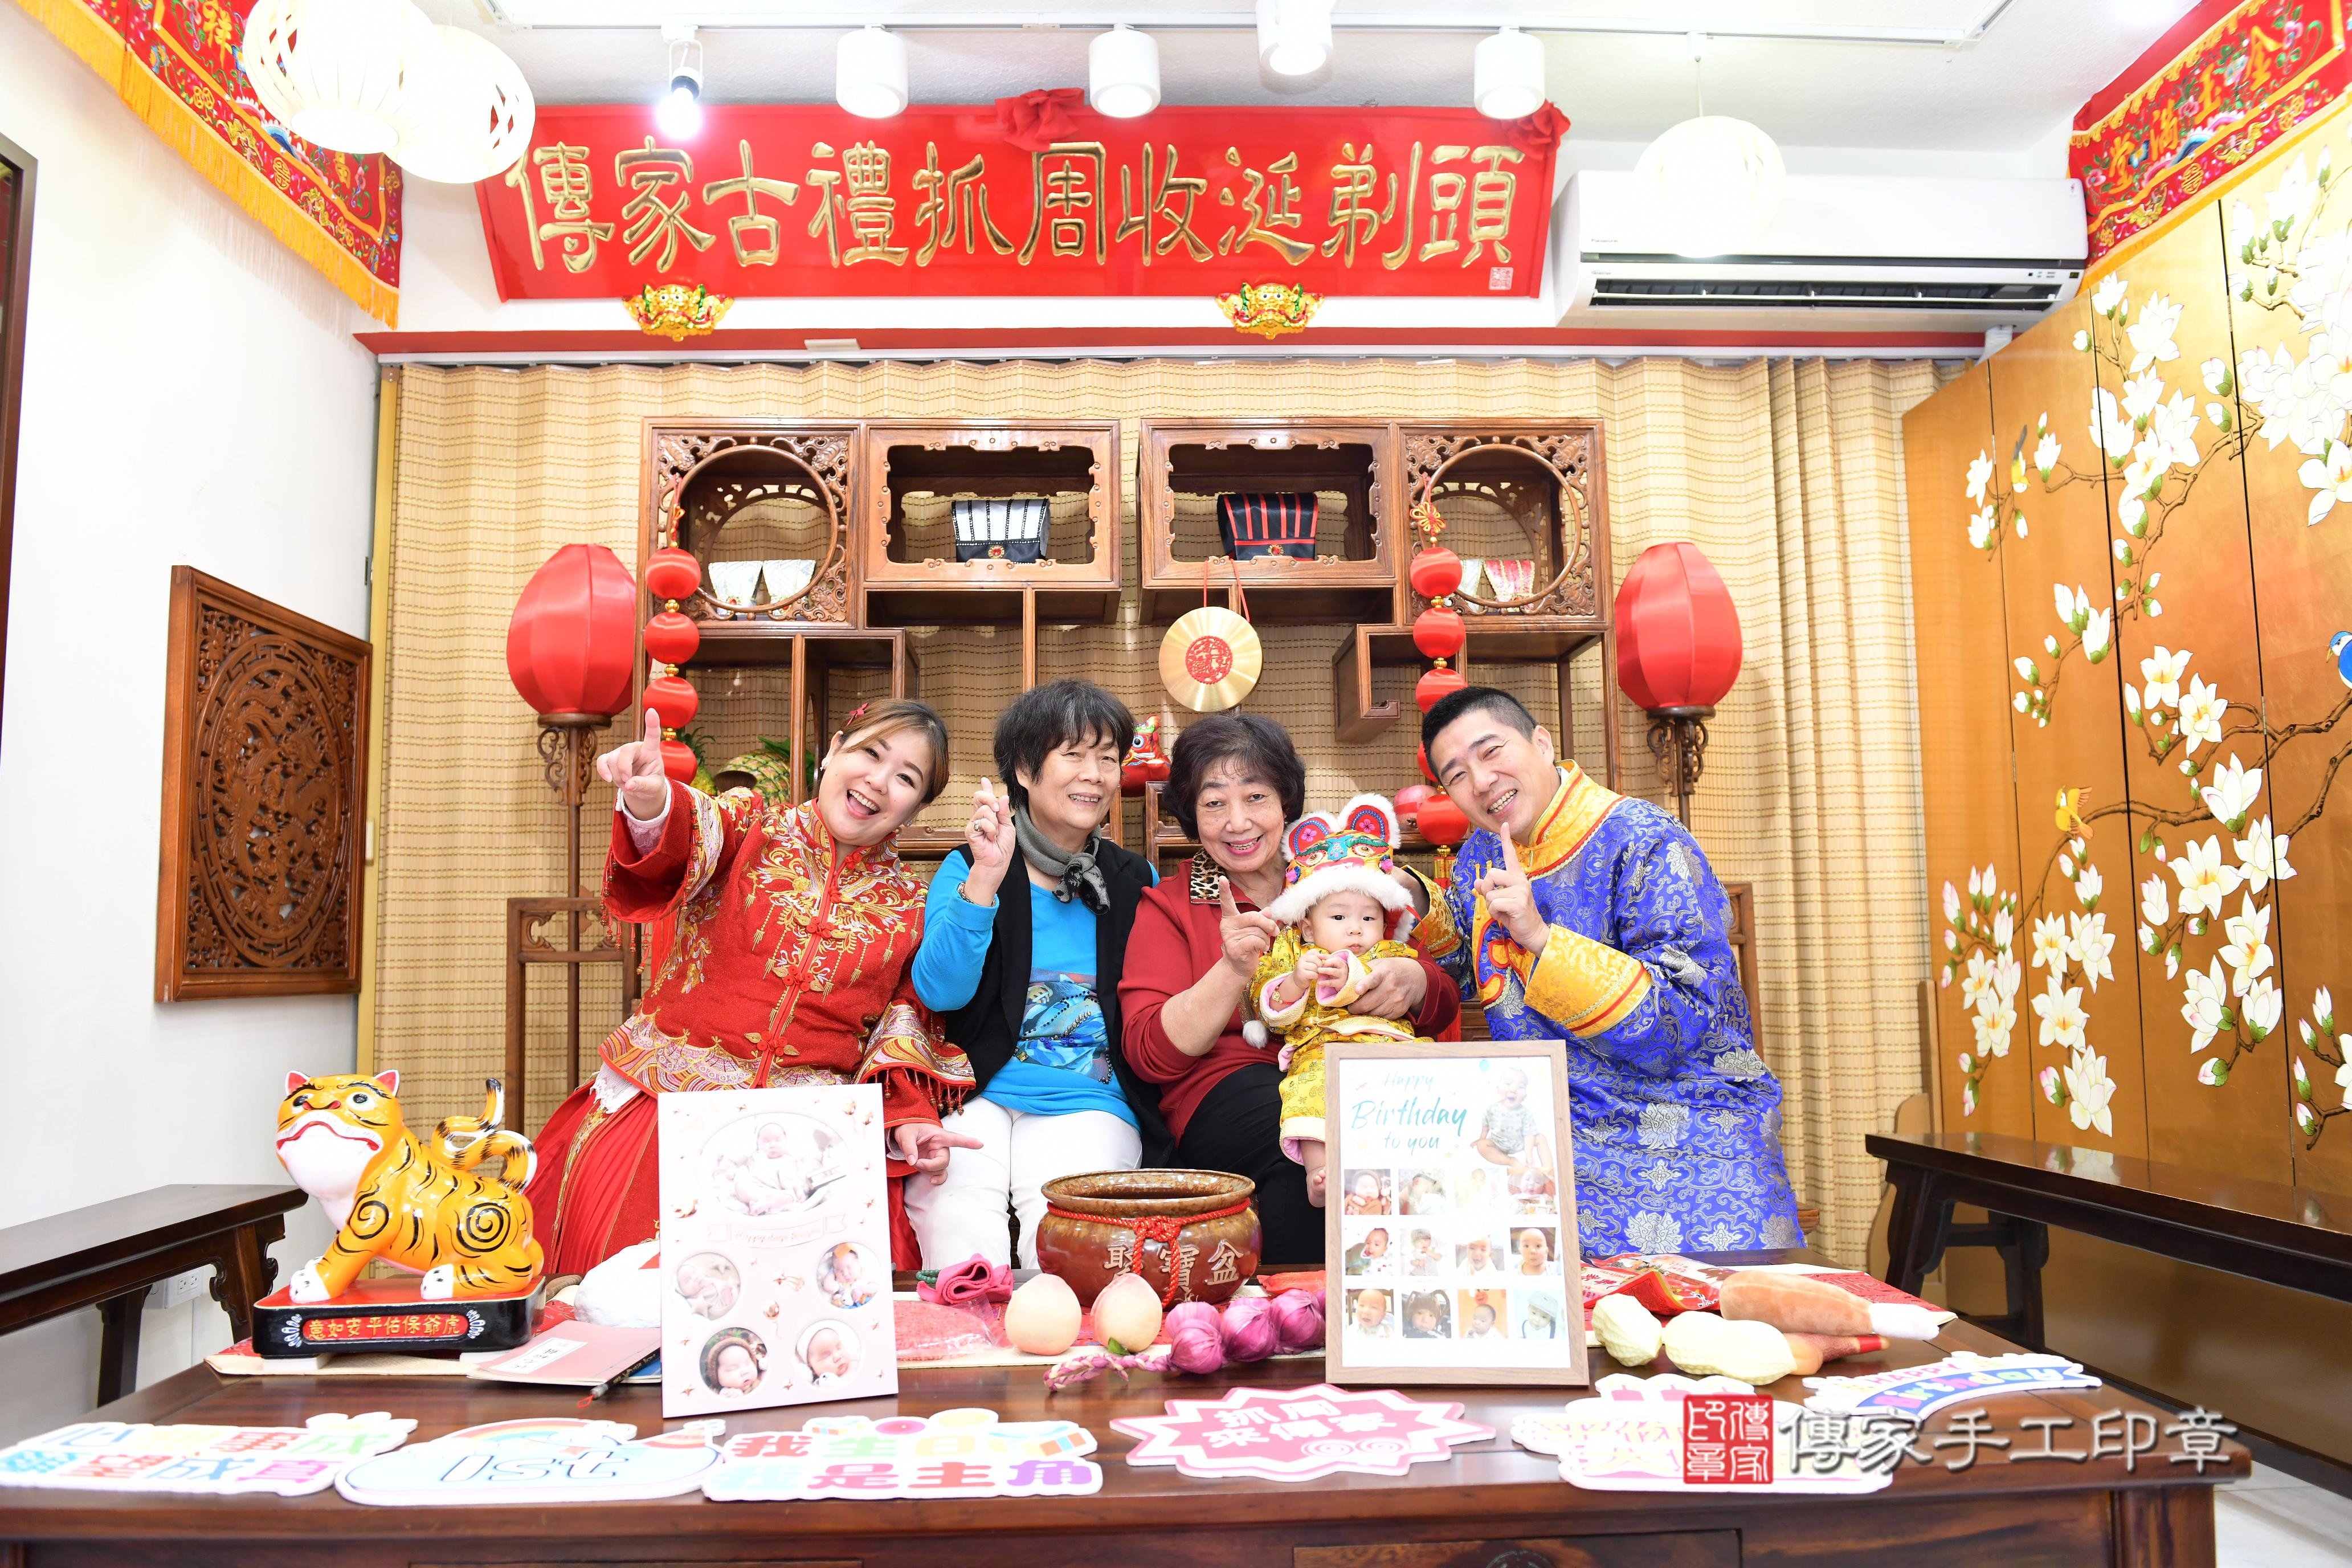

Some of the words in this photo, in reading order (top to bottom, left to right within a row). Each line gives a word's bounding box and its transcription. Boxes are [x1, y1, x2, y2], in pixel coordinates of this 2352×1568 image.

[505, 135, 1525, 274] 傳家古禮抓周收涎剃頭
[1384, 1071, 1434, 1091] Happy
[1351, 1097, 1467, 1136] Birthday
[1384, 1133, 1403, 1149] to
[1407, 1136, 1440, 1155] you
[1863, 1362, 1962, 1386] HAPPY
[1873, 1368, 2065, 1409] Birthday
[1214, 1399, 1342, 1427] 抓周
[732, 1435, 976, 1459] 我生日
[714, 1460, 1092, 1491] 我是主角
